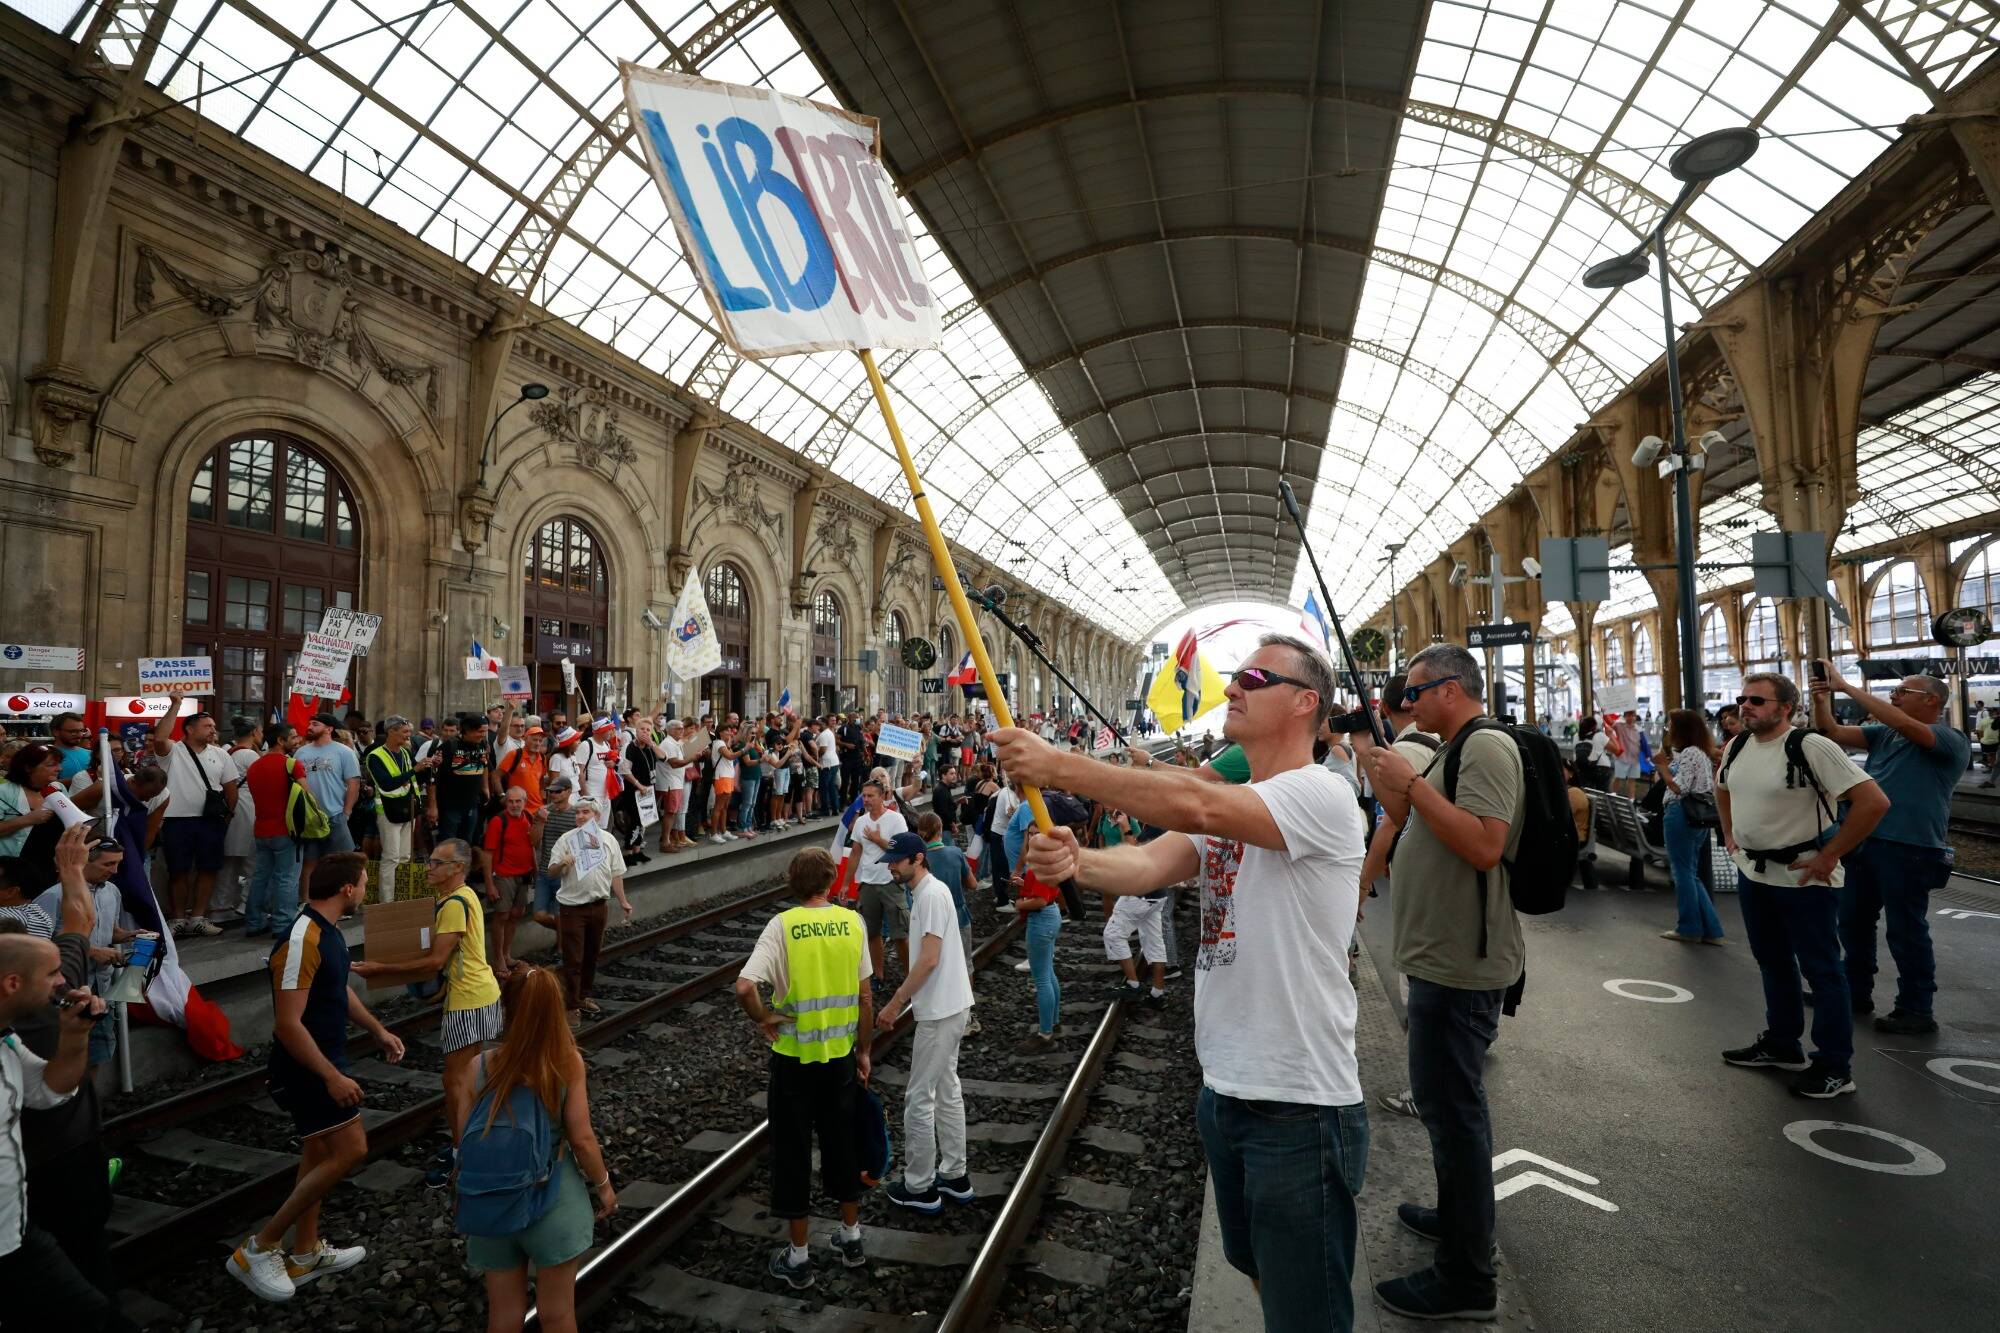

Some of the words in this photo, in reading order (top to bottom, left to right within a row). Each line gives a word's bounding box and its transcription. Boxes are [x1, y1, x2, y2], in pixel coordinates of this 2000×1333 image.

[328, 620, 342, 628] PAS
[324, 628, 341, 637] AUX
[355, 628, 367, 637] EN
[308, 633, 353, 650] VACCINATION
[155, 660, 196, 668] PASSE
[141, 669, 210, 679] SANITAIRE
[142, 682, 211, 693] BOYCOTT
[923, 682, 936, 692] W
[33, 700, 73, 709] selecta
[791, 920, 850, 940] GENEVIÈVE
